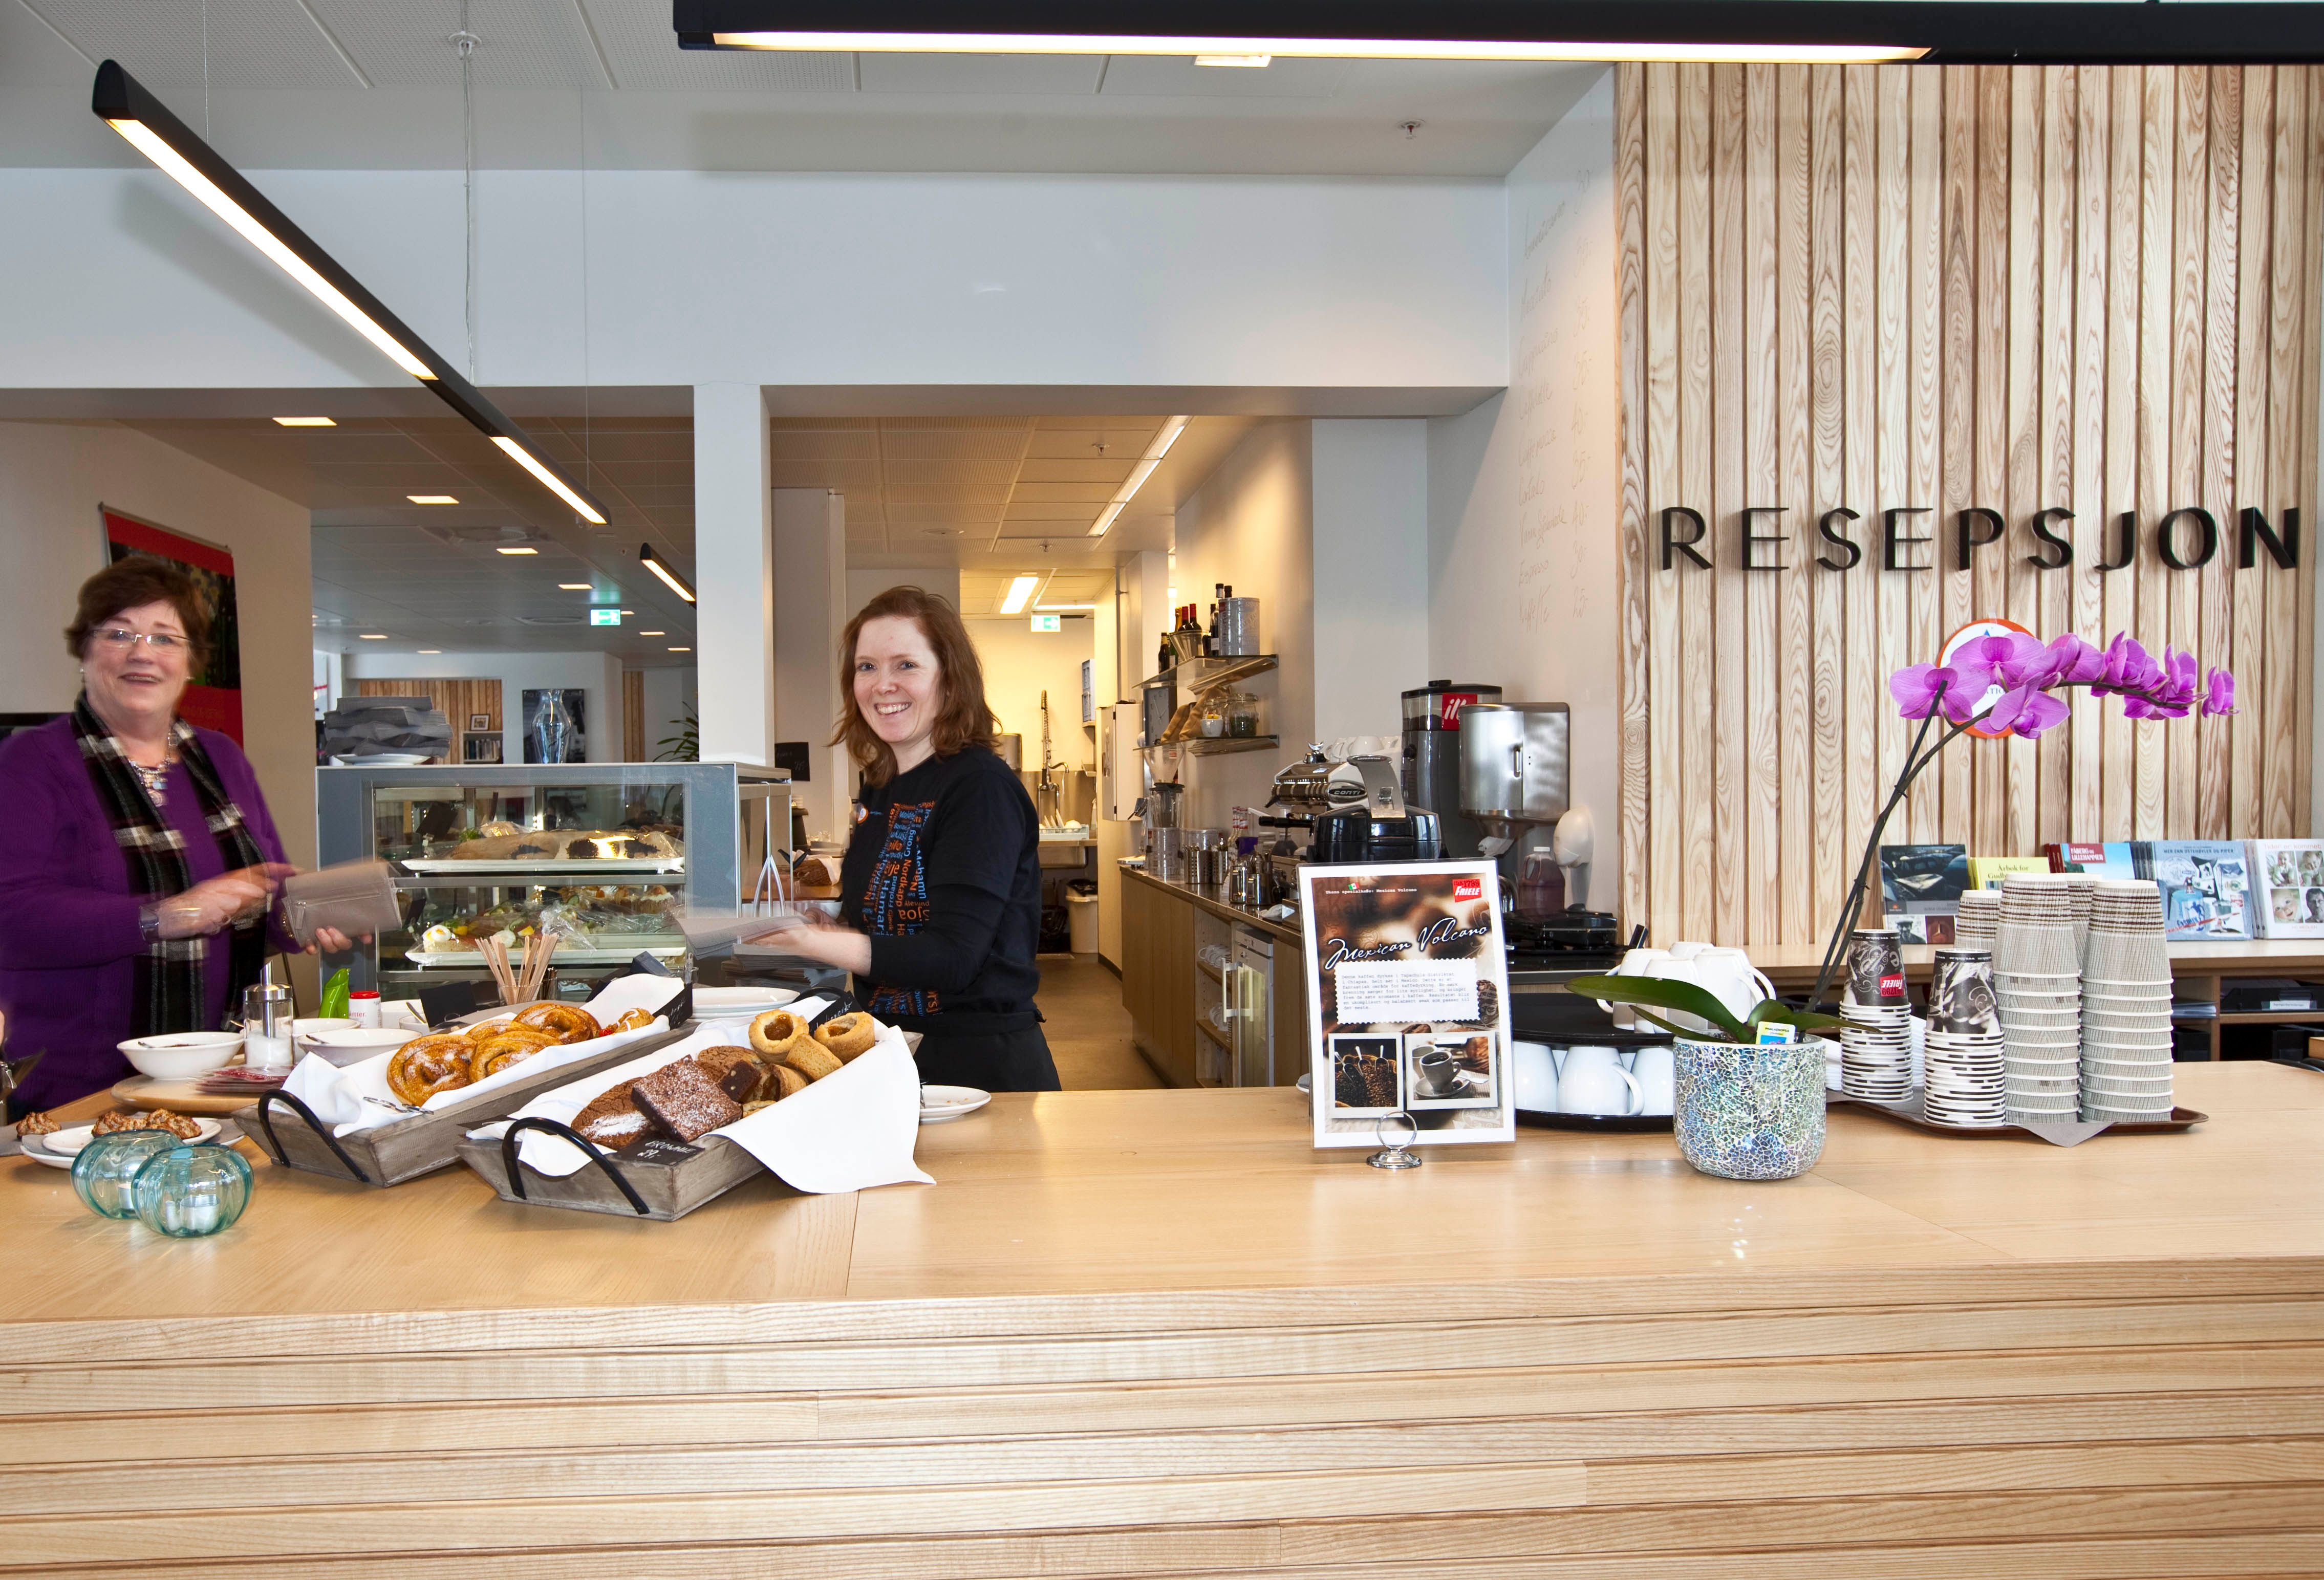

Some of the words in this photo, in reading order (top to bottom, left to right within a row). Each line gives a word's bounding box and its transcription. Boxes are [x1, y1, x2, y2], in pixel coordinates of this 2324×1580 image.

[1660, 506, 2300, 572] RESEPSJON
[903, 829, 916, 857] Grong
[1998, 863, 2018, 872] Årbok
[888, 876, 898, 908] Froland
[895, 859, 912, 907] Nordkapp
[1454, 885, 1480, 896] FRIELE
[876, 879, 890, 935] Hamar
[1324, 938, 1412, 970] Mexican
[1418, 917, 1488, 951] Volcano
[1881, 979, 1903, 990] FRIELE
[645, 1140, 697, 1154] BROWNIE
